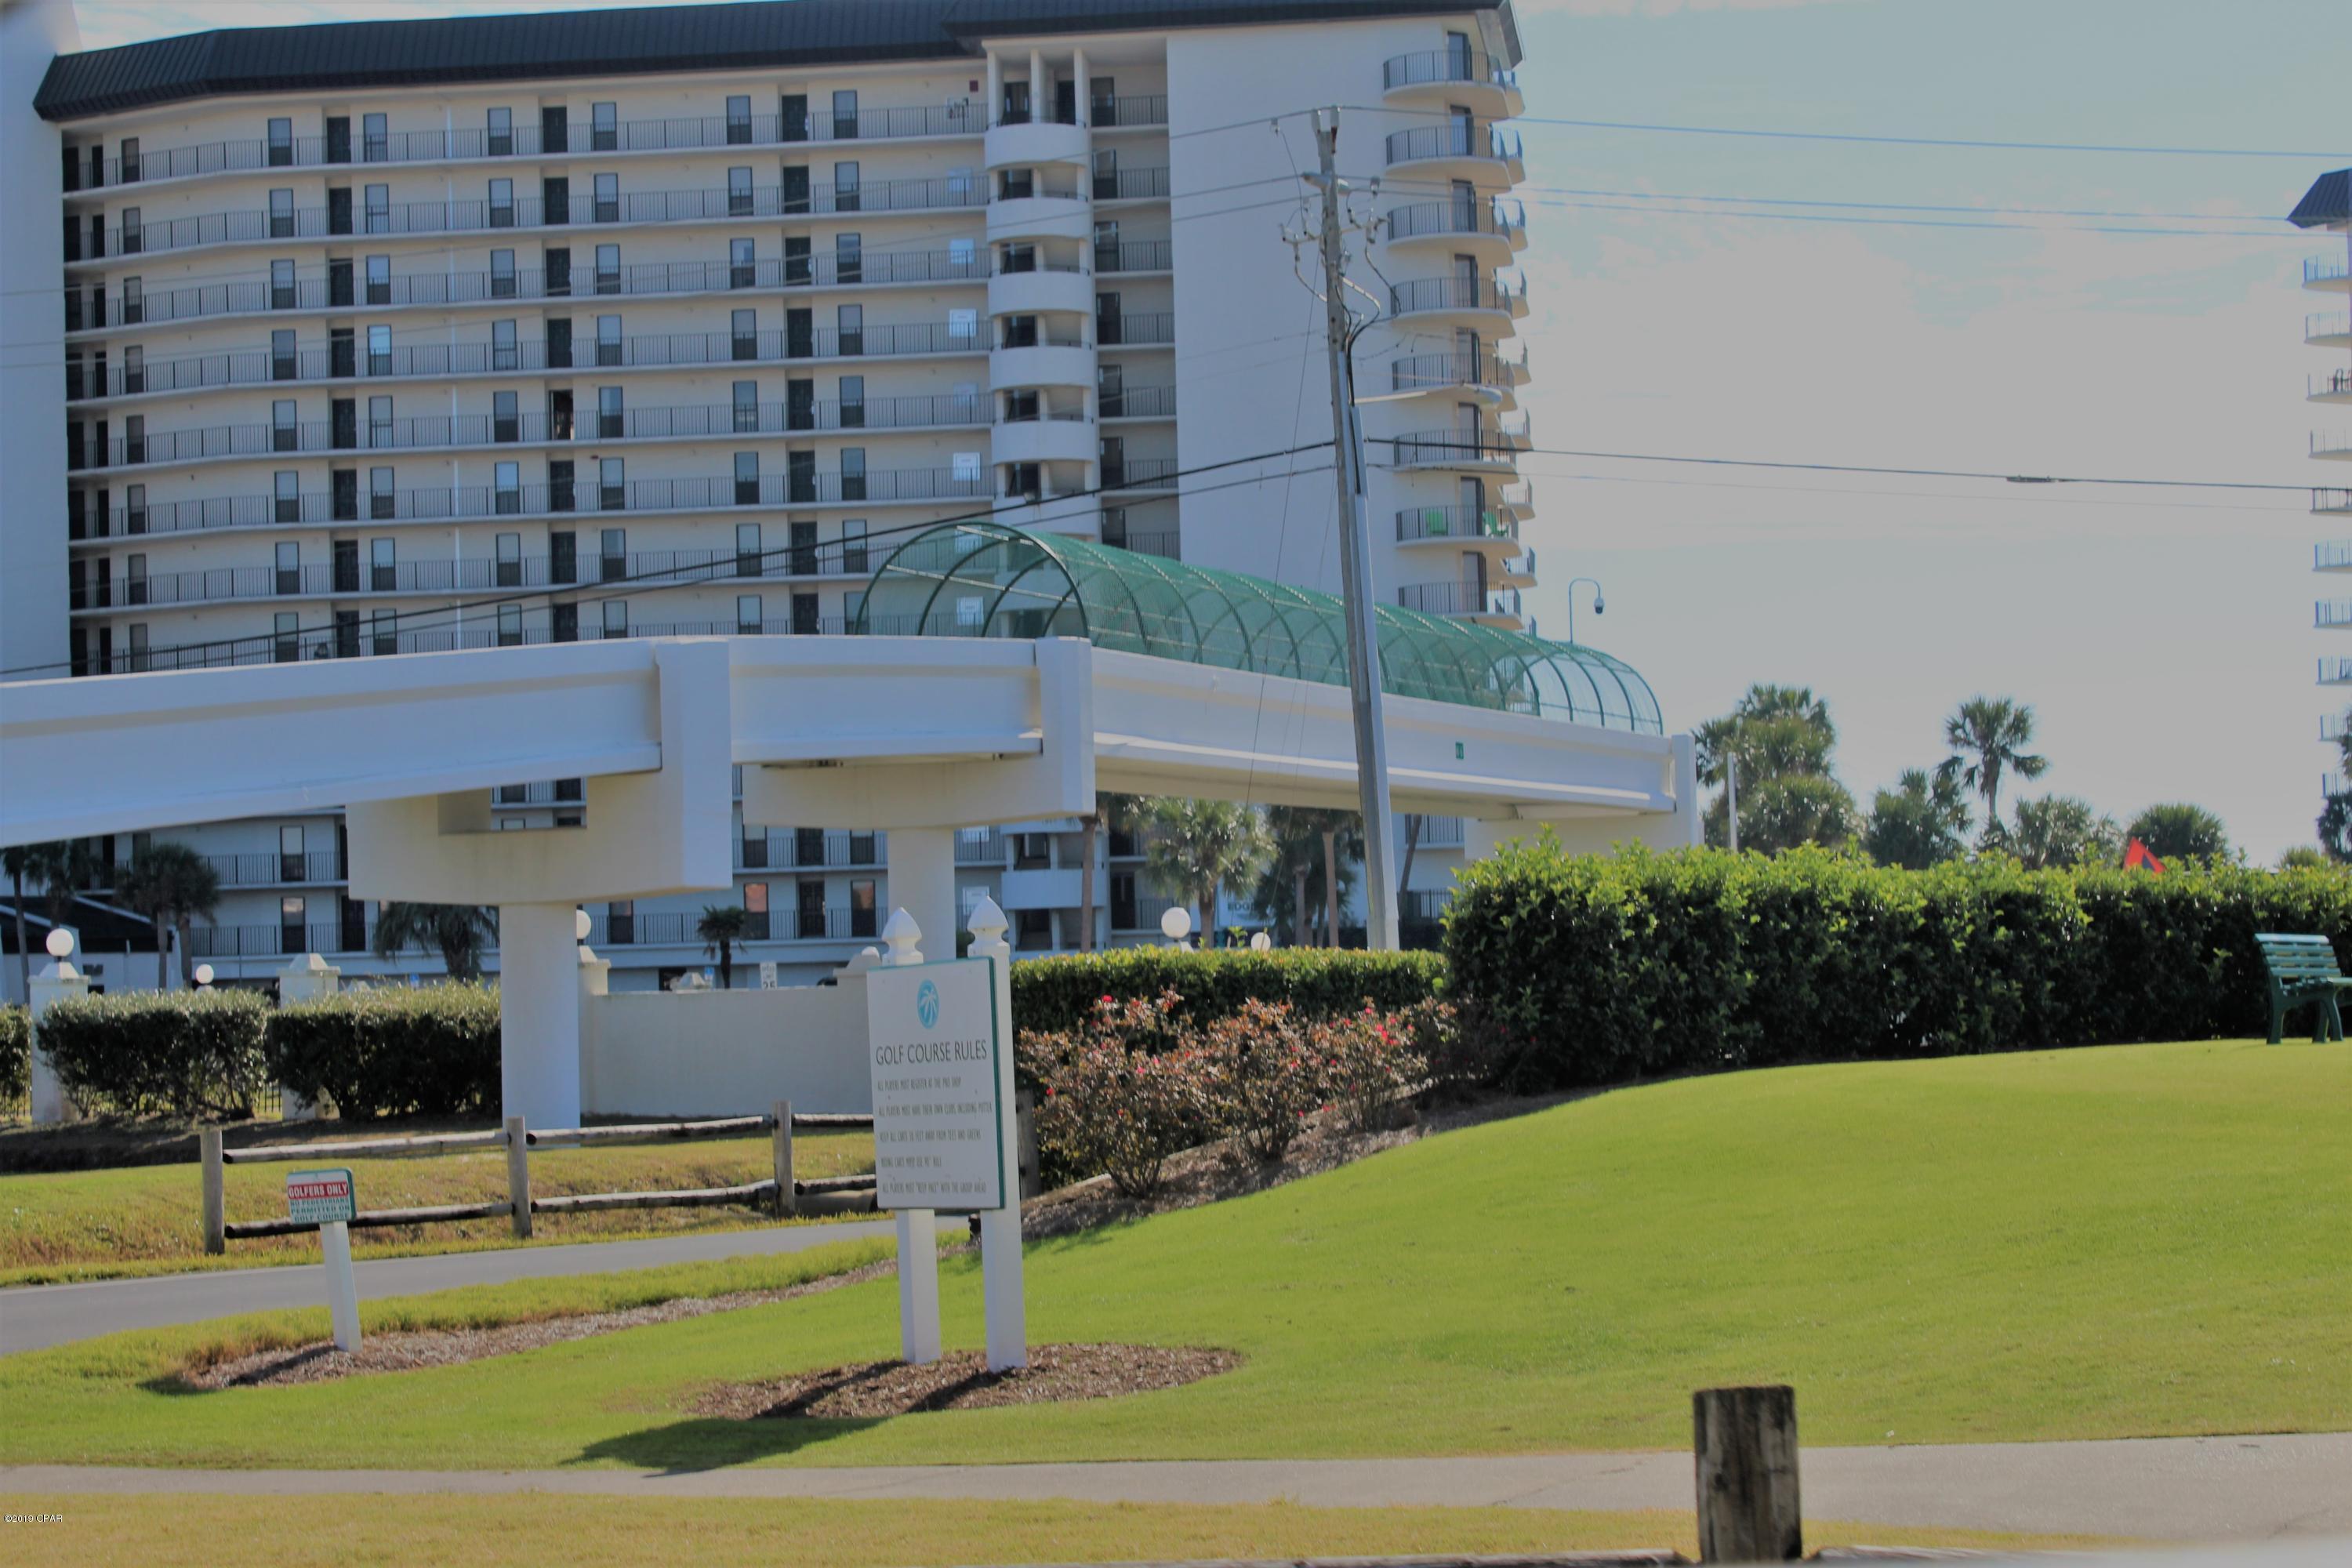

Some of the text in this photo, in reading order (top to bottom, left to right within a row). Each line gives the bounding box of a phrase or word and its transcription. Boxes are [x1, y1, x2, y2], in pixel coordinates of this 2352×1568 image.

[876, 1039, 988, 1065] GOLF COURSE RULES
[289, 1183, 347, 1199] GOLFERS ONLY
